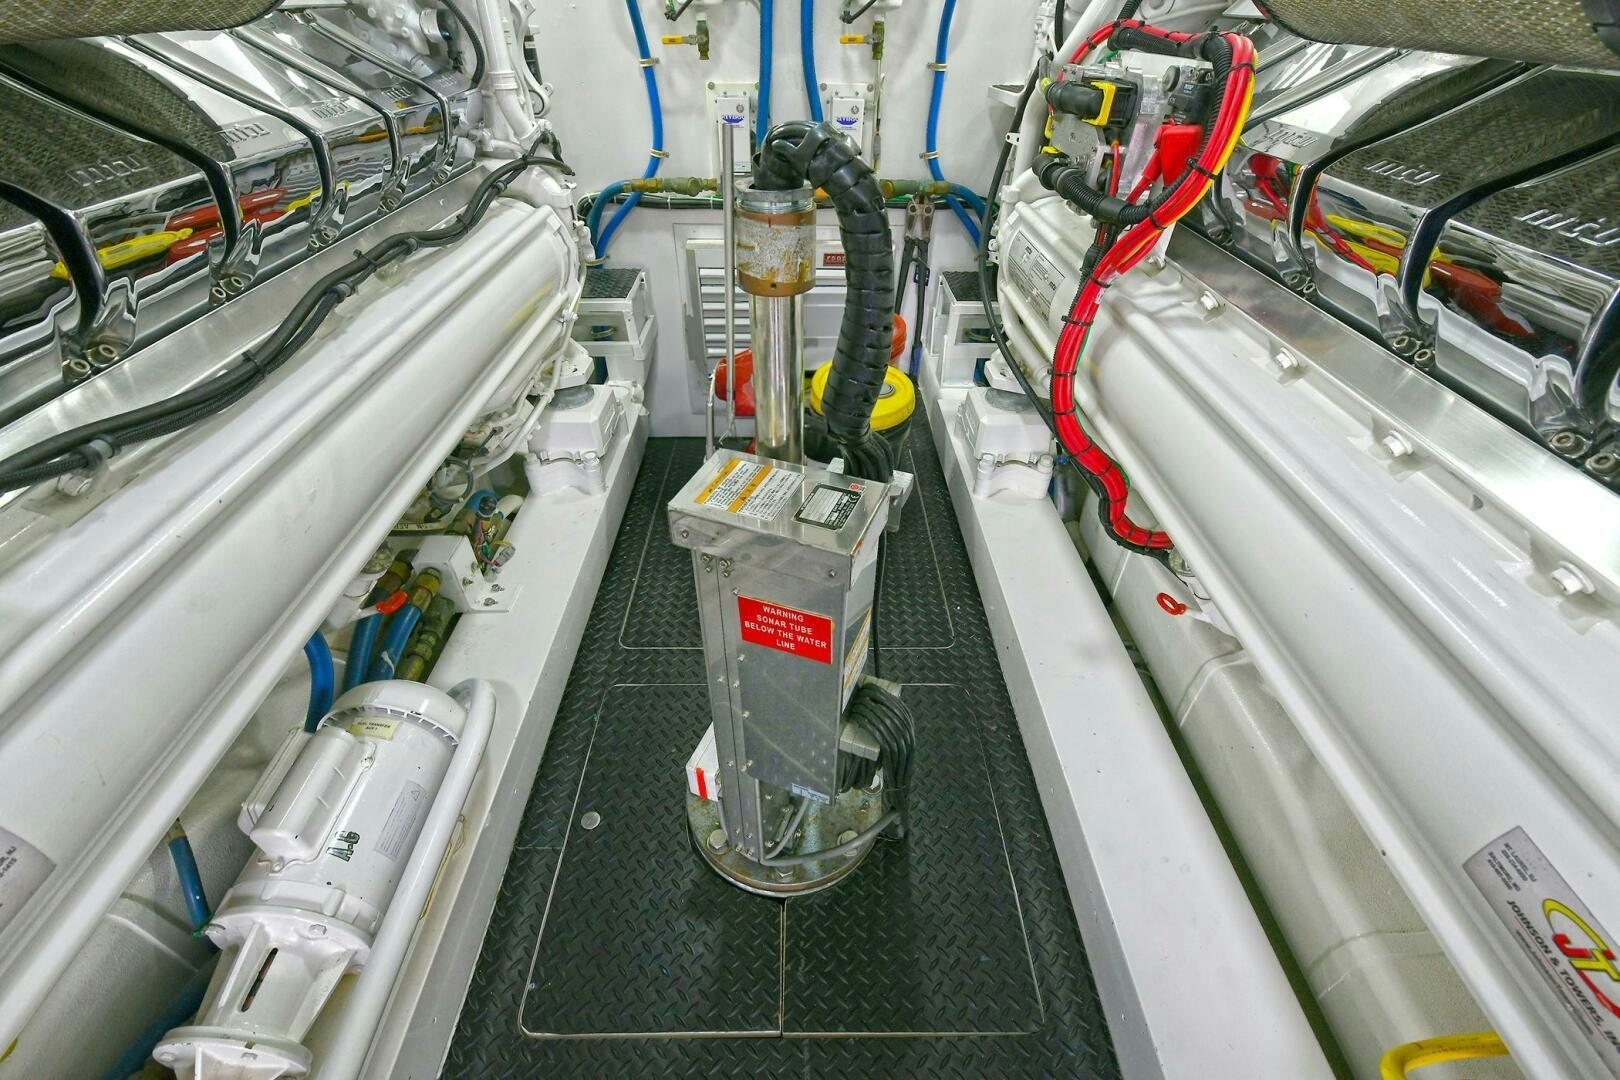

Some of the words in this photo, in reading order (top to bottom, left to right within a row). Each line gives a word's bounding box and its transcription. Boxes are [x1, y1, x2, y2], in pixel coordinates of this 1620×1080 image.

[756, 614, 787, 629] SONAR
[789, 623, 813, 635] TUBE
[762, 605, 804, 623] WARNING
[744, 620, 775, 635] BELOW
[777, 629, 794, 640] THE
[796, 635, 827, 649] WATER
[776, 639, 796, 650] LINE
[1506, 899, 1552, 955] JOHNSON
[1550, 956, 1560, 967] &
[1560, 967, 1604, 1026] TOWERS,
